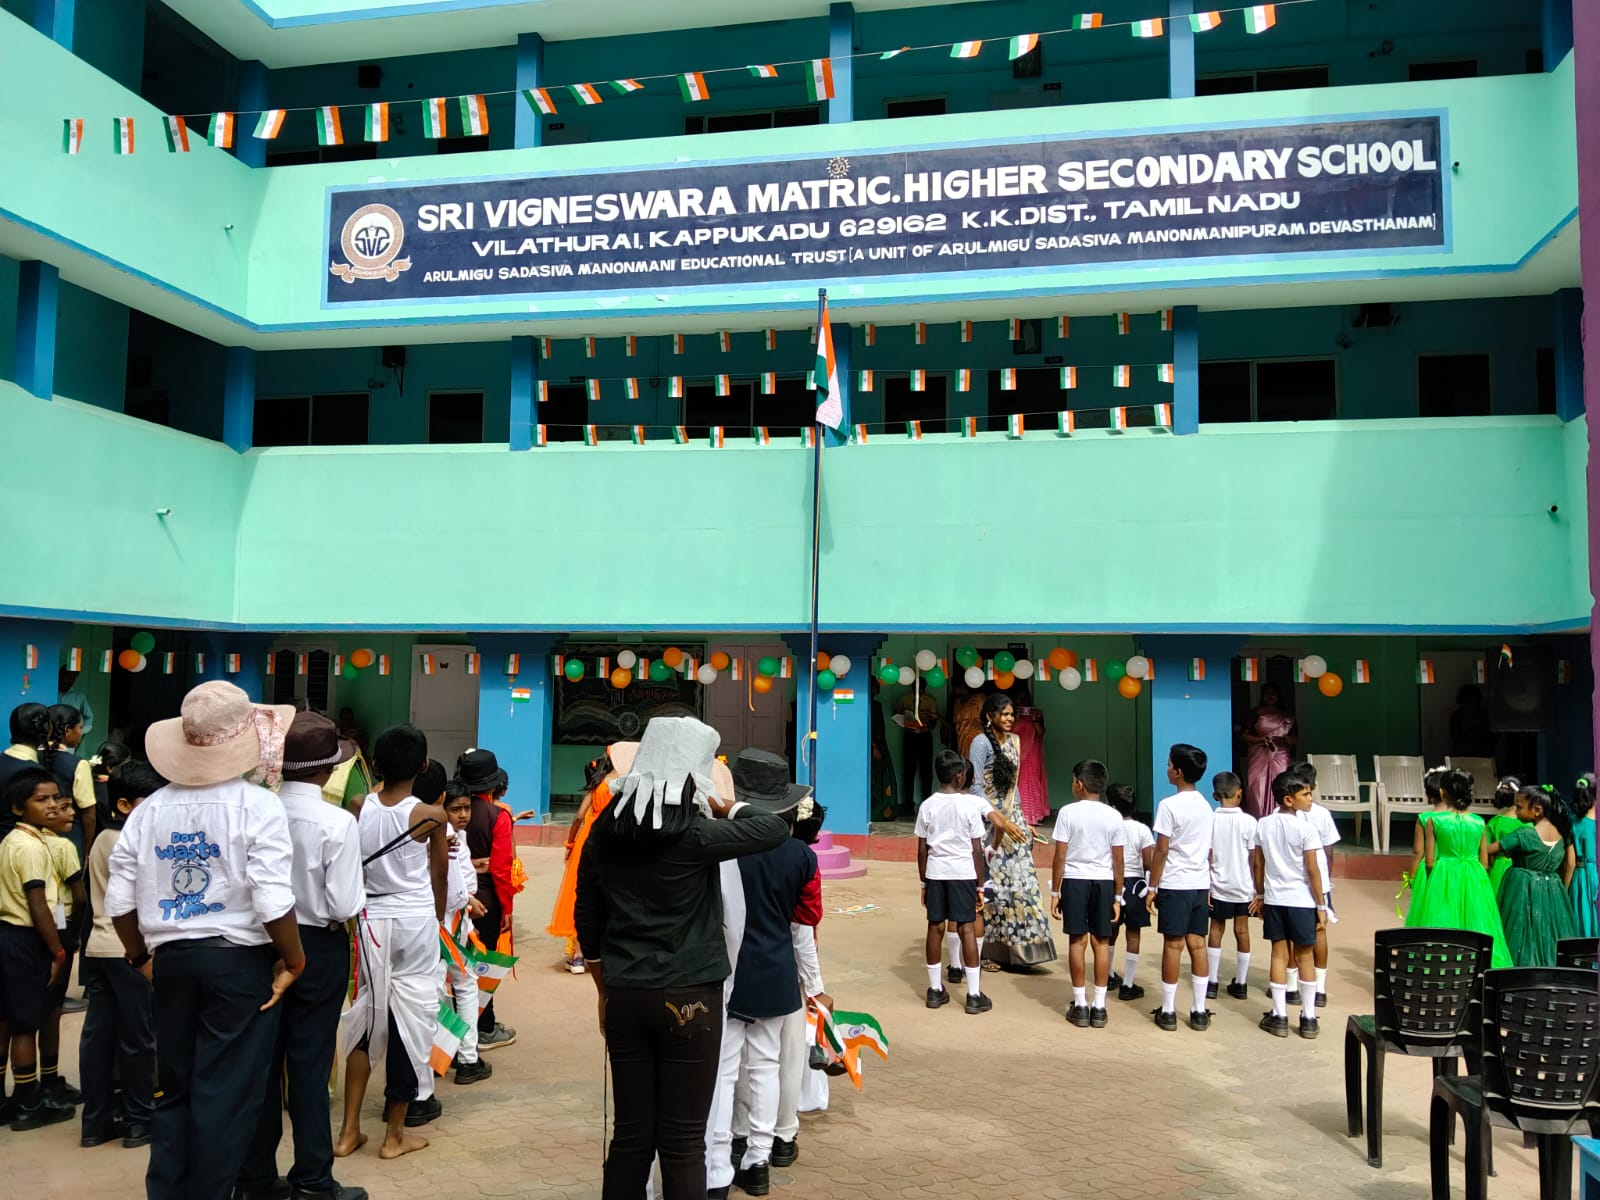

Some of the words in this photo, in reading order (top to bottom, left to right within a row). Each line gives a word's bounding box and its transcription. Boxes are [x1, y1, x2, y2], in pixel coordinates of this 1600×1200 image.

[417, 202, 474, 232] SRI
[483, 188, 738, 228] VIGNESWARA
[1057, 147, 1294, 192] SECONDARY
[1297, 139, 1437, 178] SCHOOL
[839, 213, 947, 238] 629162
[1103, 196, 1204, 220] TAMIL
[1207, 191, 1301, 214] NADU
[423, 267, 494, 283] ARULMIGU
[498, 263, 574, 280] SADASIVA
[577, 259, 676, 276] MANONMANI
[680, 253, 786, 271] EDUCATIONAL
[791, 249, 847, 264] TRUST
[868, 245, 907, 260] UNIT
[911, 244, 934, 258] OF
[937, 238, 1031, 256] ARULMIGU
[1035, 233, 1122, 251] SADASIVA
[1127, 222, 1306, 245] MANONMANIPURAM
